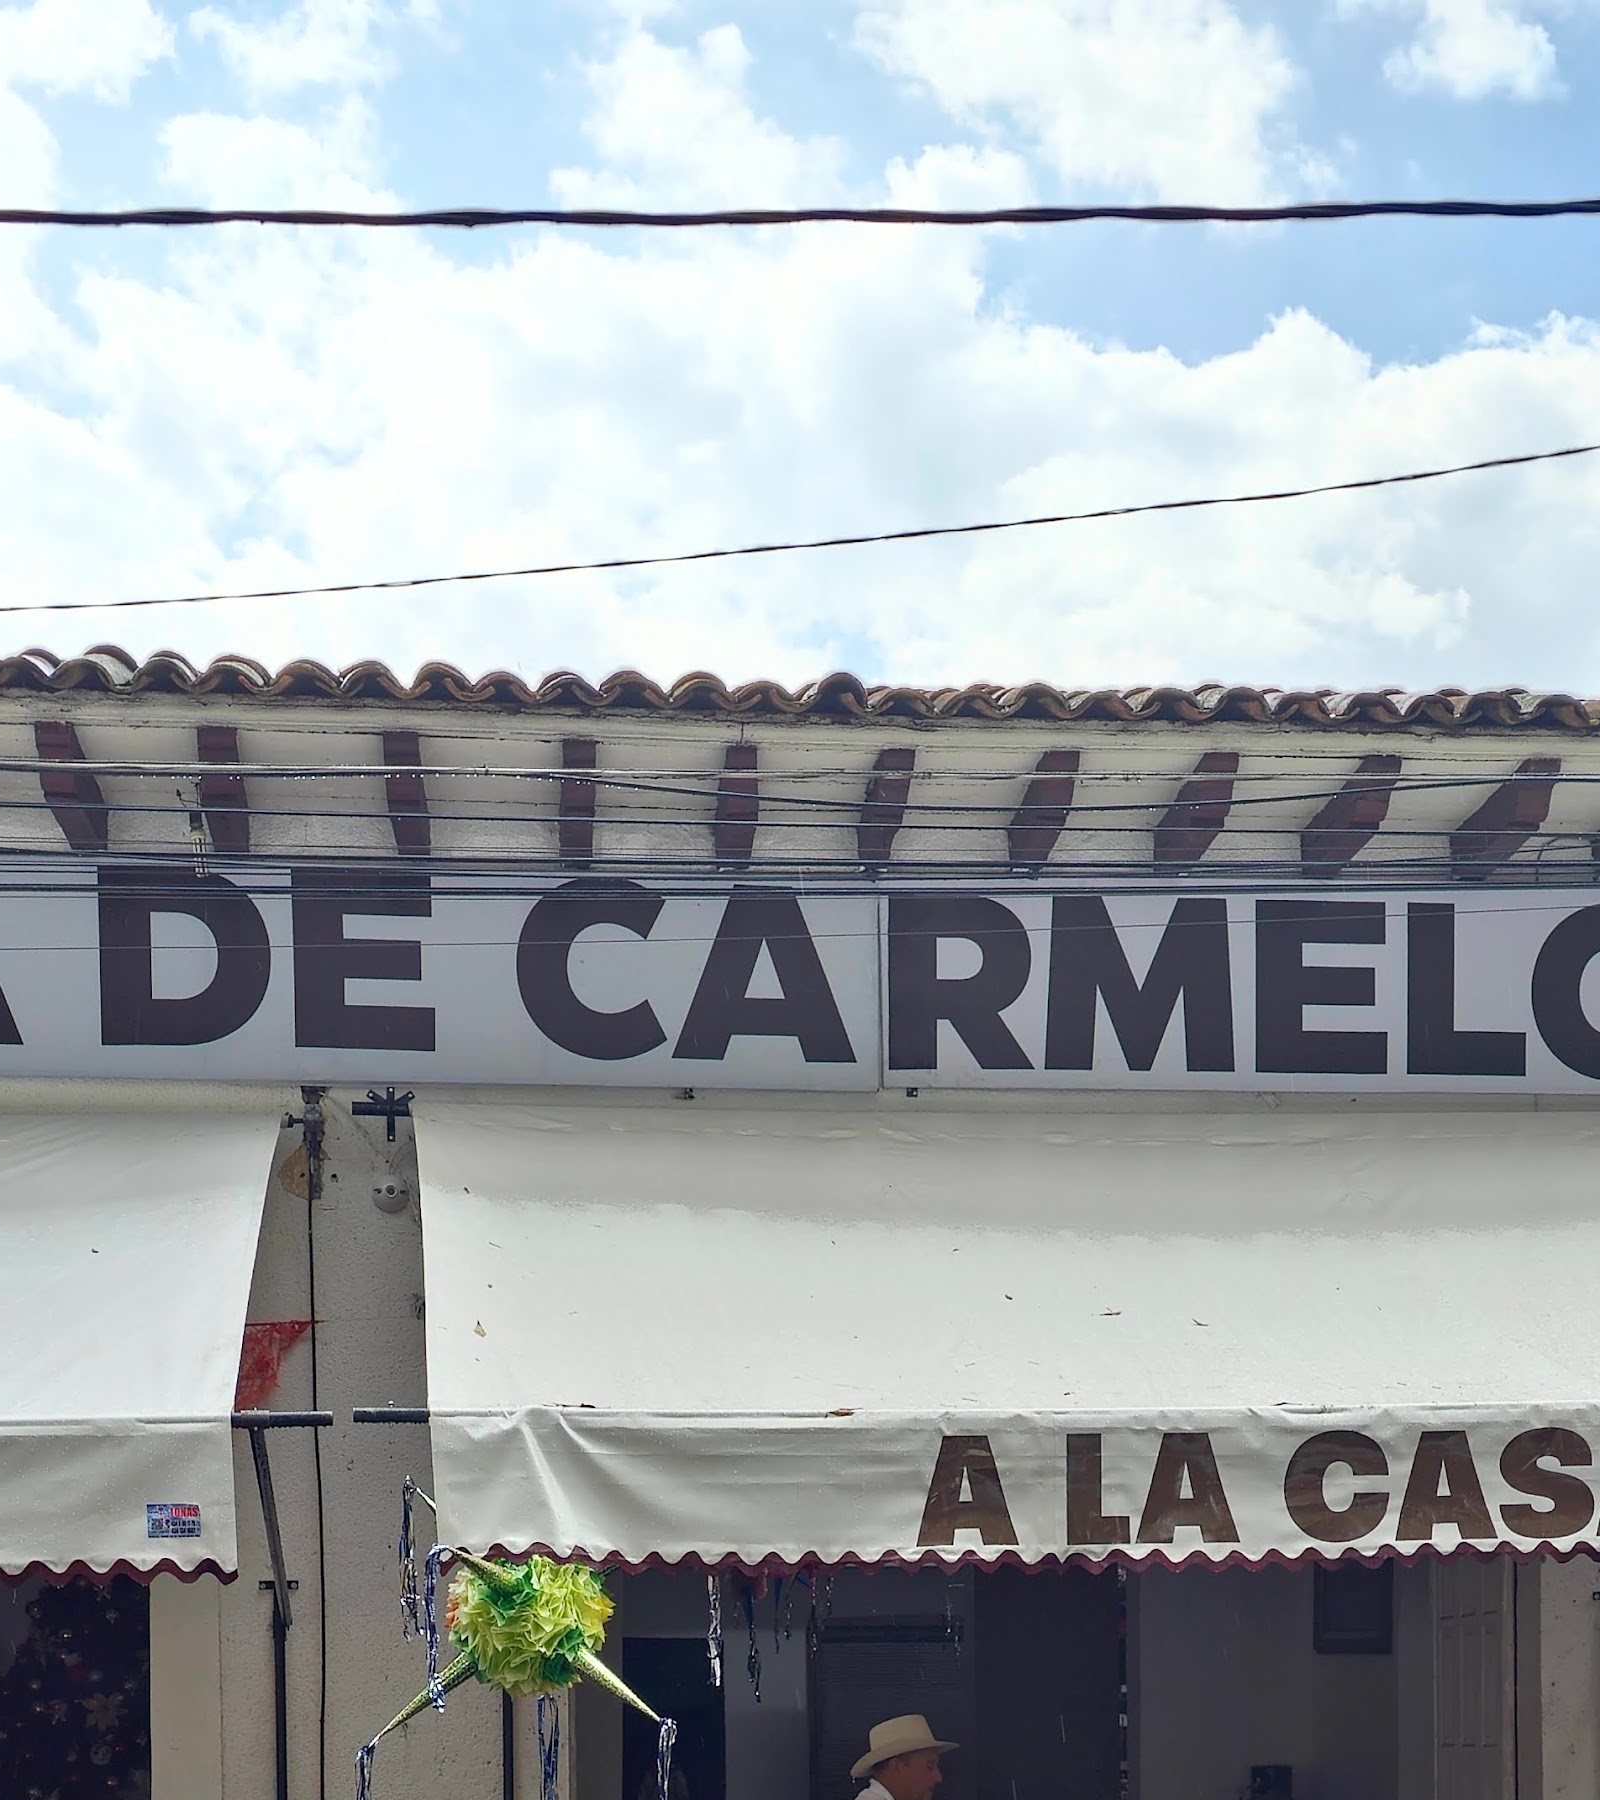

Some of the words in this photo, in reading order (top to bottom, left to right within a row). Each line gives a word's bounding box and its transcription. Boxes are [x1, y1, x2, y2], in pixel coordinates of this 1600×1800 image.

[97, 864, 435, 1052] DE
[916, 1434, 1018, 1547] A
[1066, 1432, 1241, 1545] LA
